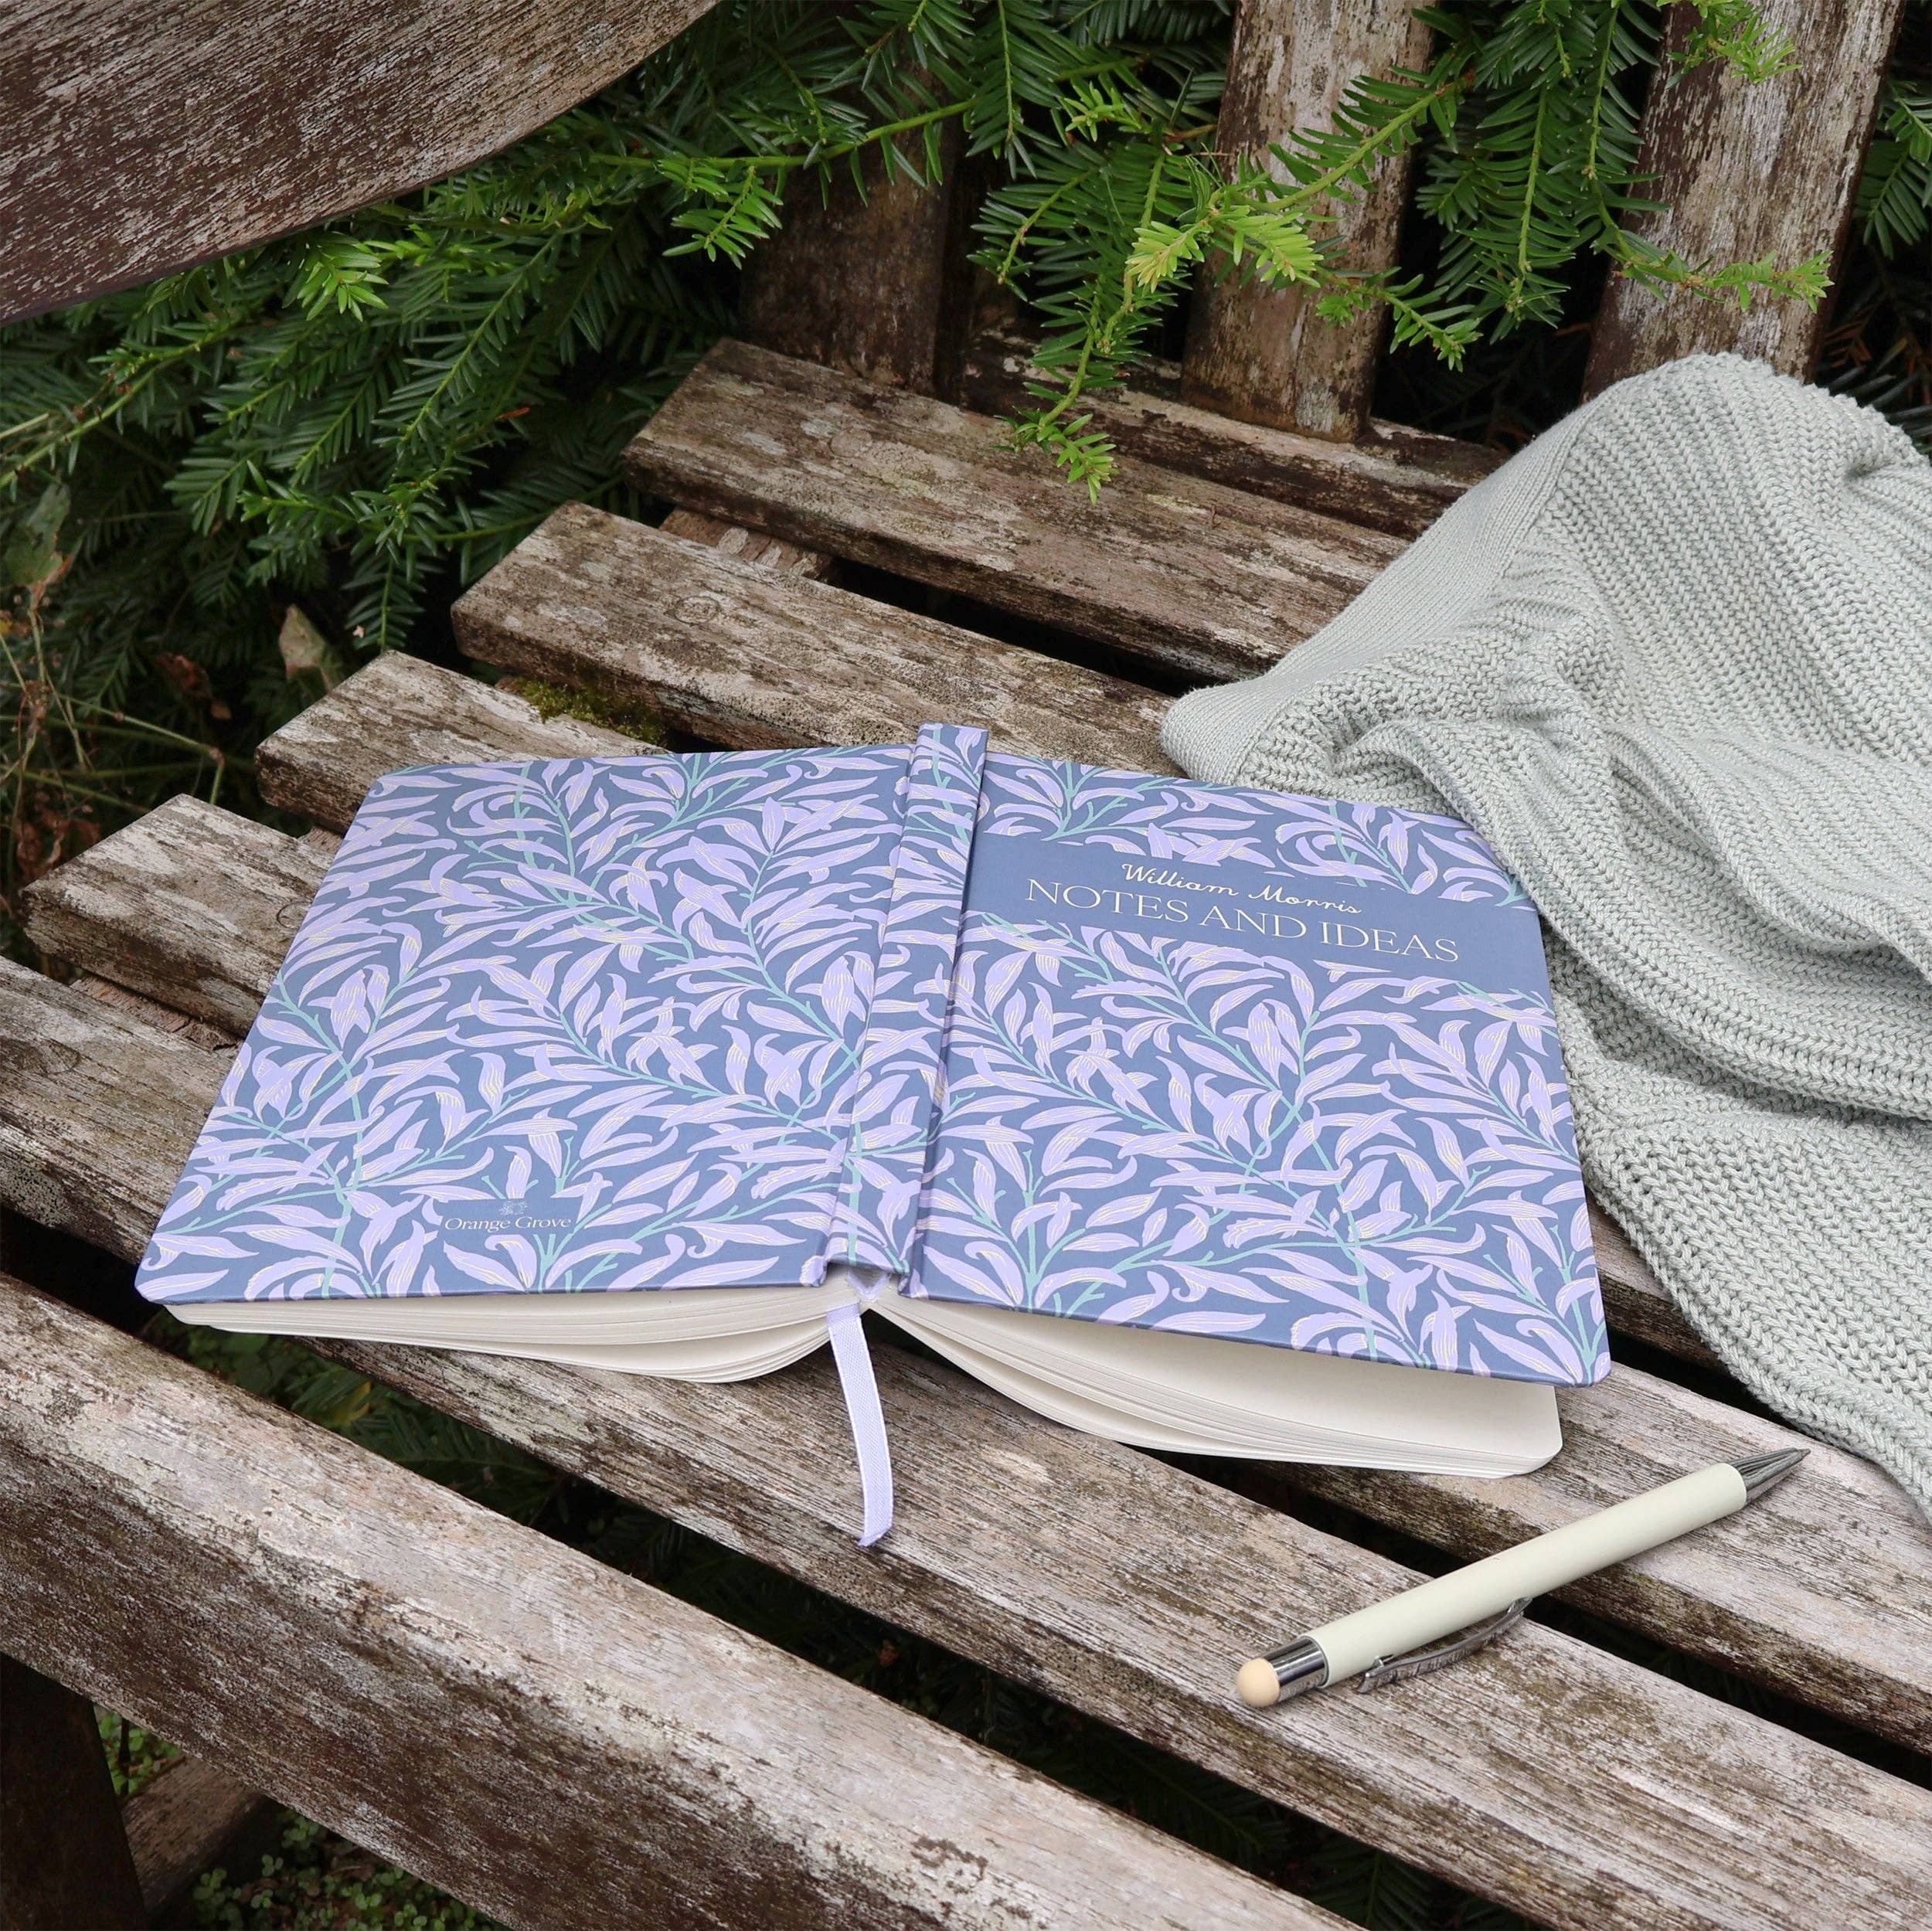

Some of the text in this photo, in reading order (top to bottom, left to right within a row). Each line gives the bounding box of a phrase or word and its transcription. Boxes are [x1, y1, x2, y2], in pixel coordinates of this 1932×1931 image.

[1121, 862, 1362, 914] William Morris
[1027, 878, 1459, 963] NOTES AND IDEAS
[444, 1216, 571, 1233] Orange Grove
